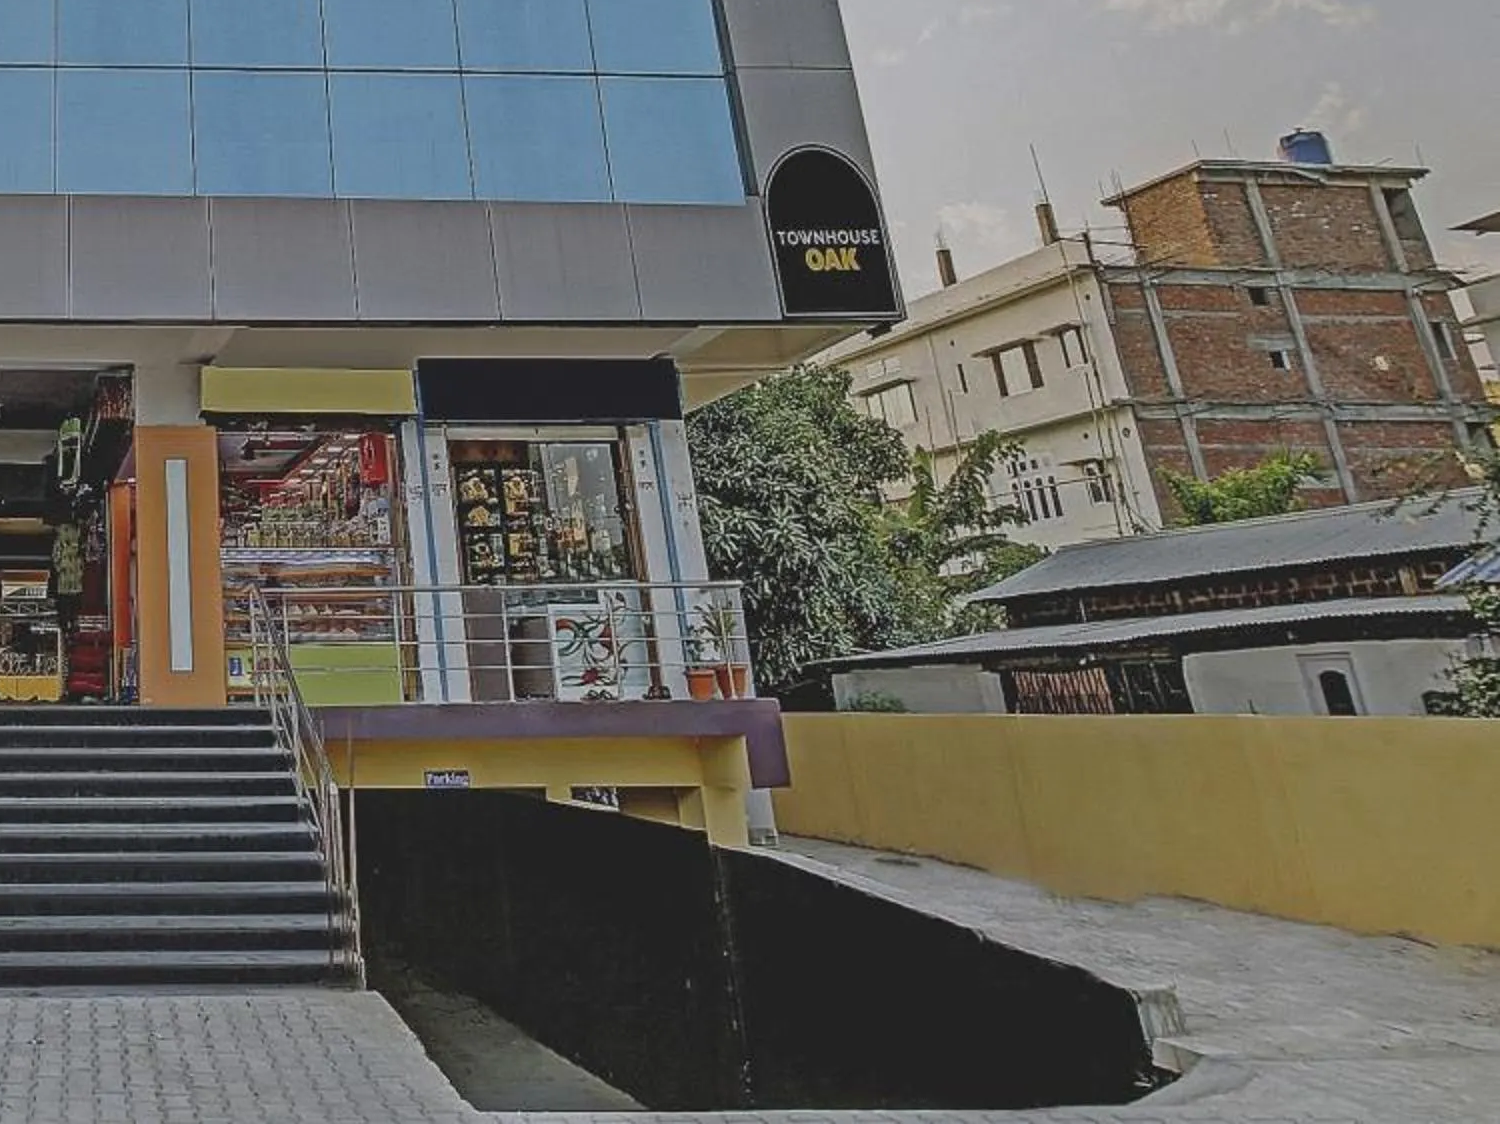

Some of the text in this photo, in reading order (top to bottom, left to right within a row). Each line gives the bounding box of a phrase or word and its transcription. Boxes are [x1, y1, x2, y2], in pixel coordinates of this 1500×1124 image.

[777, 229, 880, 246] TOWNHOUSE
[804, 247, 861, 271] OAK
[426, 771, 469, 787] Parking
